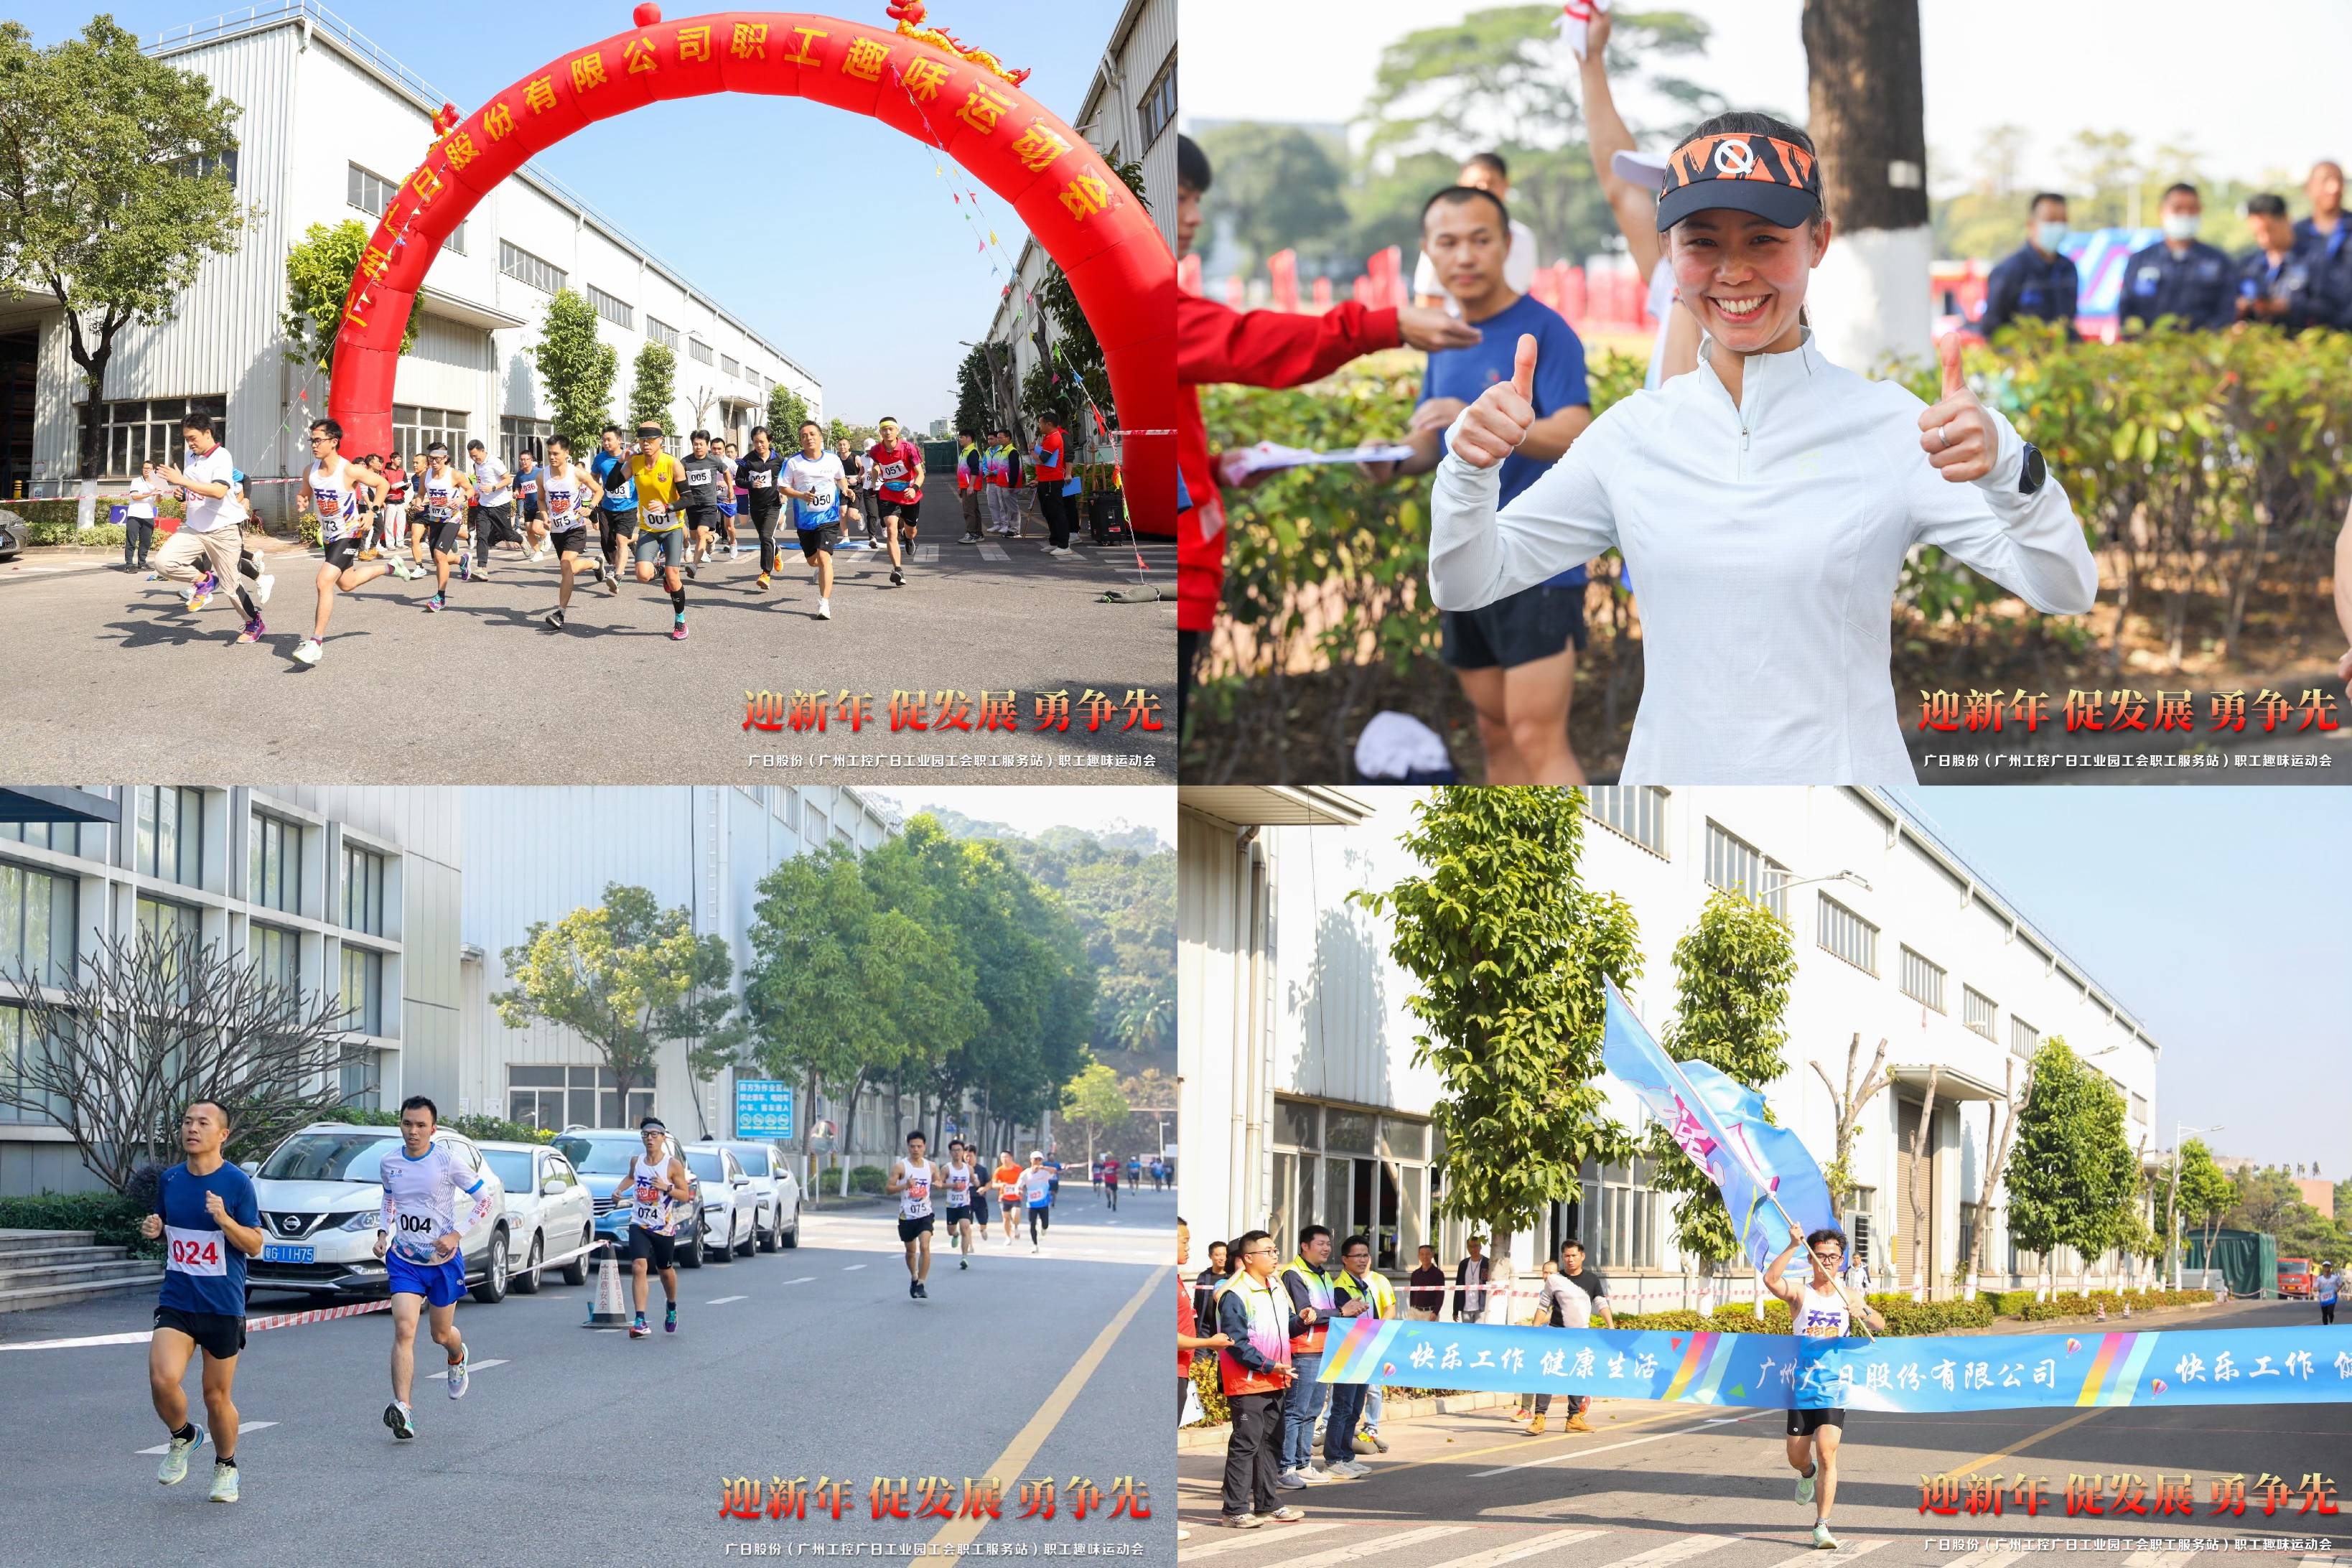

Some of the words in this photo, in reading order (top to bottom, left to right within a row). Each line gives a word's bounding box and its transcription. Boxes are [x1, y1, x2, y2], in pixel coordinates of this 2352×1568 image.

[885, 465, 902, 475] 051
[691, 472, 706, 482] 005
[523, 483, 536, 492] 036
[812, 494, 831, 506] 050
[554, 515, 571, 528] 075
[648, 513, 670, 525] 001
[638, 1208, 658, 1219] 074
[910, 1203, 927, 1213] 075
[401, 1213, 431, 1234] 004
[172, 1240, 218, 1265] 024
[1409, 1341, 1525, 1375] 快乐工作
[1539, 1346, 1659, 1380] 健康生活
[2175, 1350, 2315, 1384] 快乐工作
[1756, 1356, 2056, 1392] 广州广日股份有限公司
